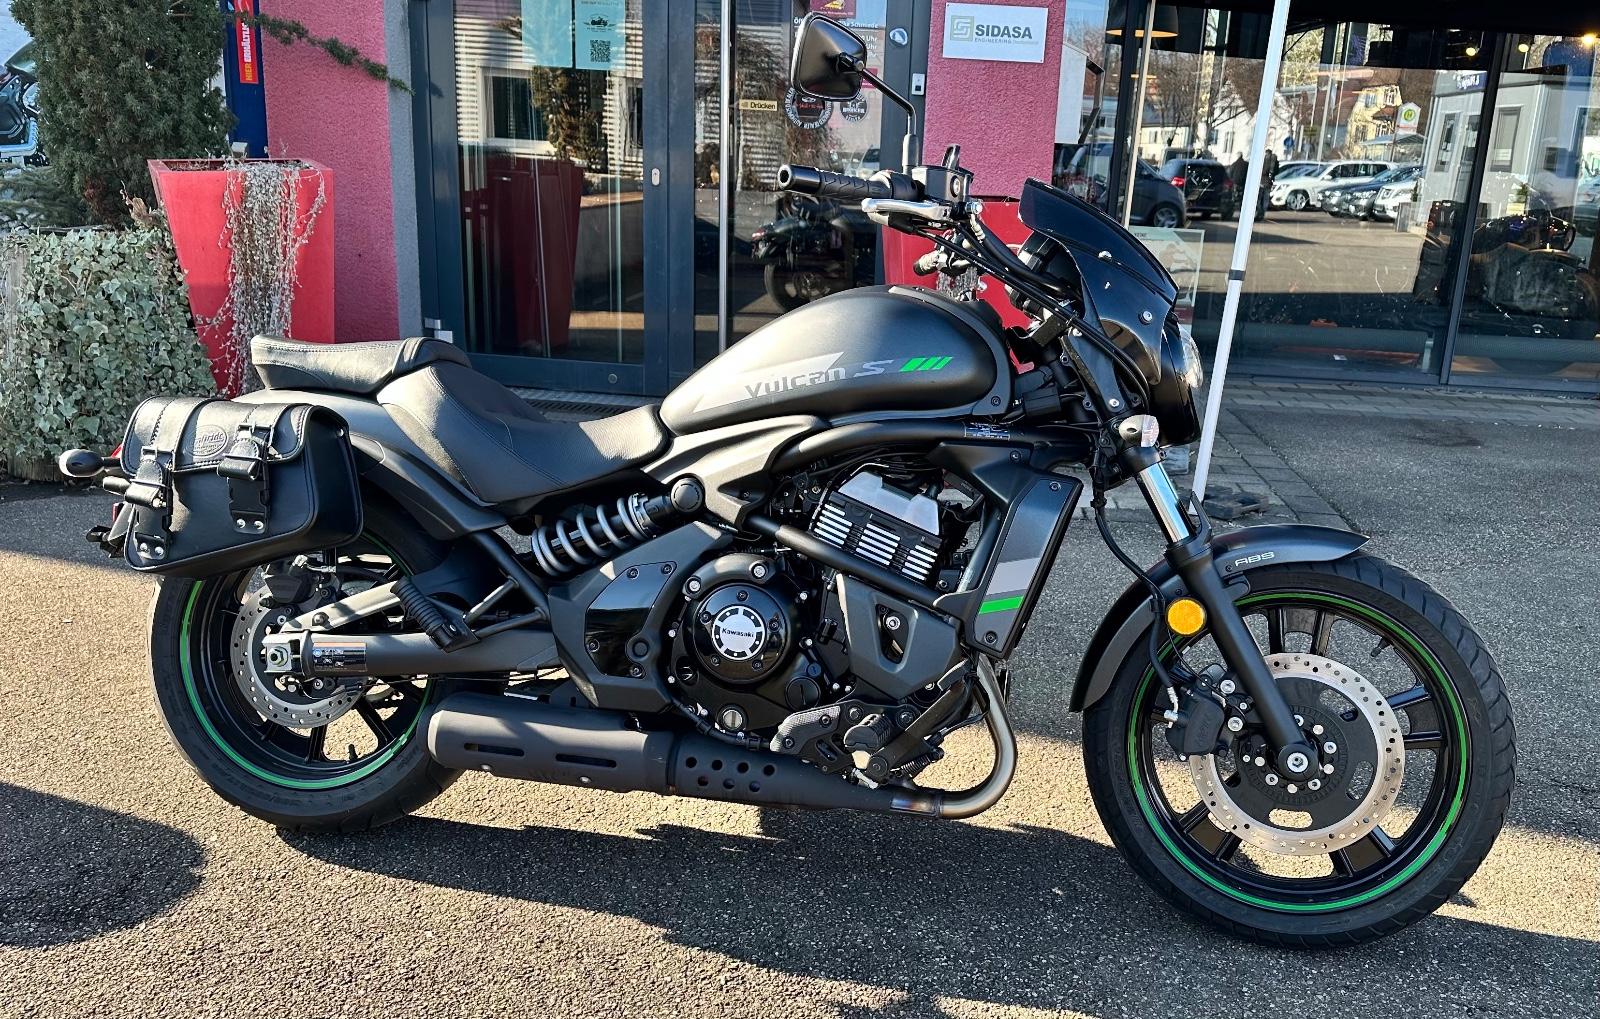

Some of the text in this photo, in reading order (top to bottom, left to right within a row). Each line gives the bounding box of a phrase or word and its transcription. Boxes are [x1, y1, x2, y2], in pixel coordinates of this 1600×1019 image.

[975, 24, 1033, 39] SIDASA
[241, 22, 252, 80] HIER ERHÄLTLI
[750, 101, 776, 109] Drücken
[744, 359, 895, 399] Vulcan S
[1234, 551, 1275, 567] ABS
[721, 627, 755, 638] Kawasaki
